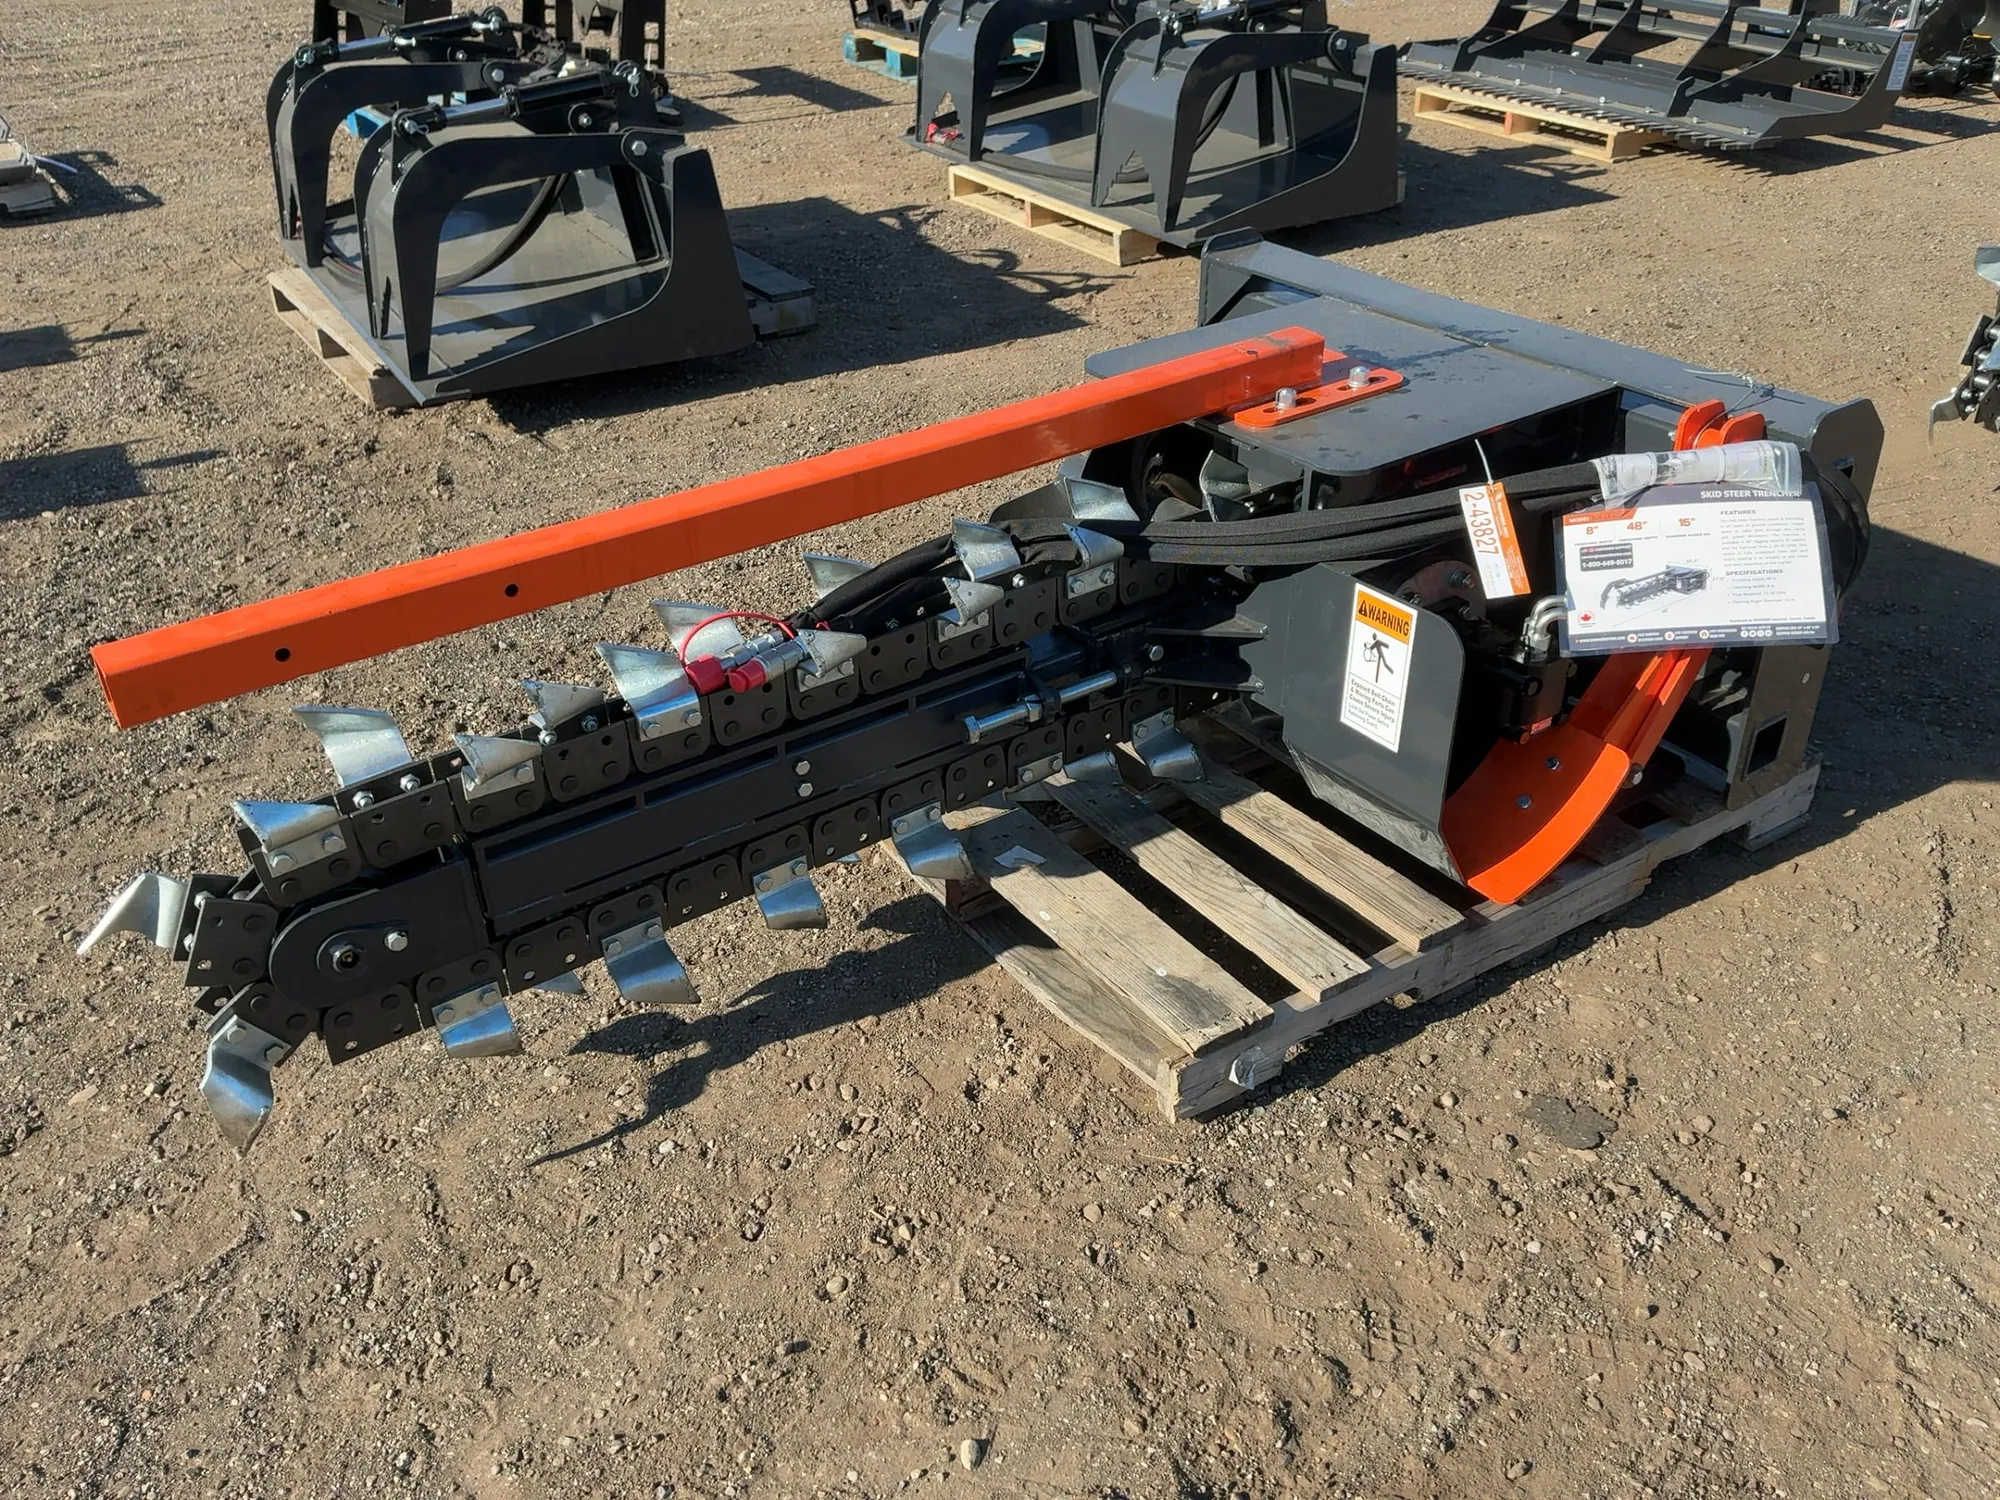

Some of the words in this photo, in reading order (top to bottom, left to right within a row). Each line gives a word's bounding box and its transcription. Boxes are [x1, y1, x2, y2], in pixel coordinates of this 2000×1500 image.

[1700, 490, 1722, 499] SKID
[1723, 489, 1751, 498] STEER
[1464, 492, 1499, 555] 2-43827
[1626, 520, 1648, 531] 48"
[1678, 517, 1696, 527] 15"
[1725, 568, 1784, 577] SPECIFICATIONS
[1368, 603, 1410, 636] WARNING
[1351, 678, 1371, 694] Exposed
